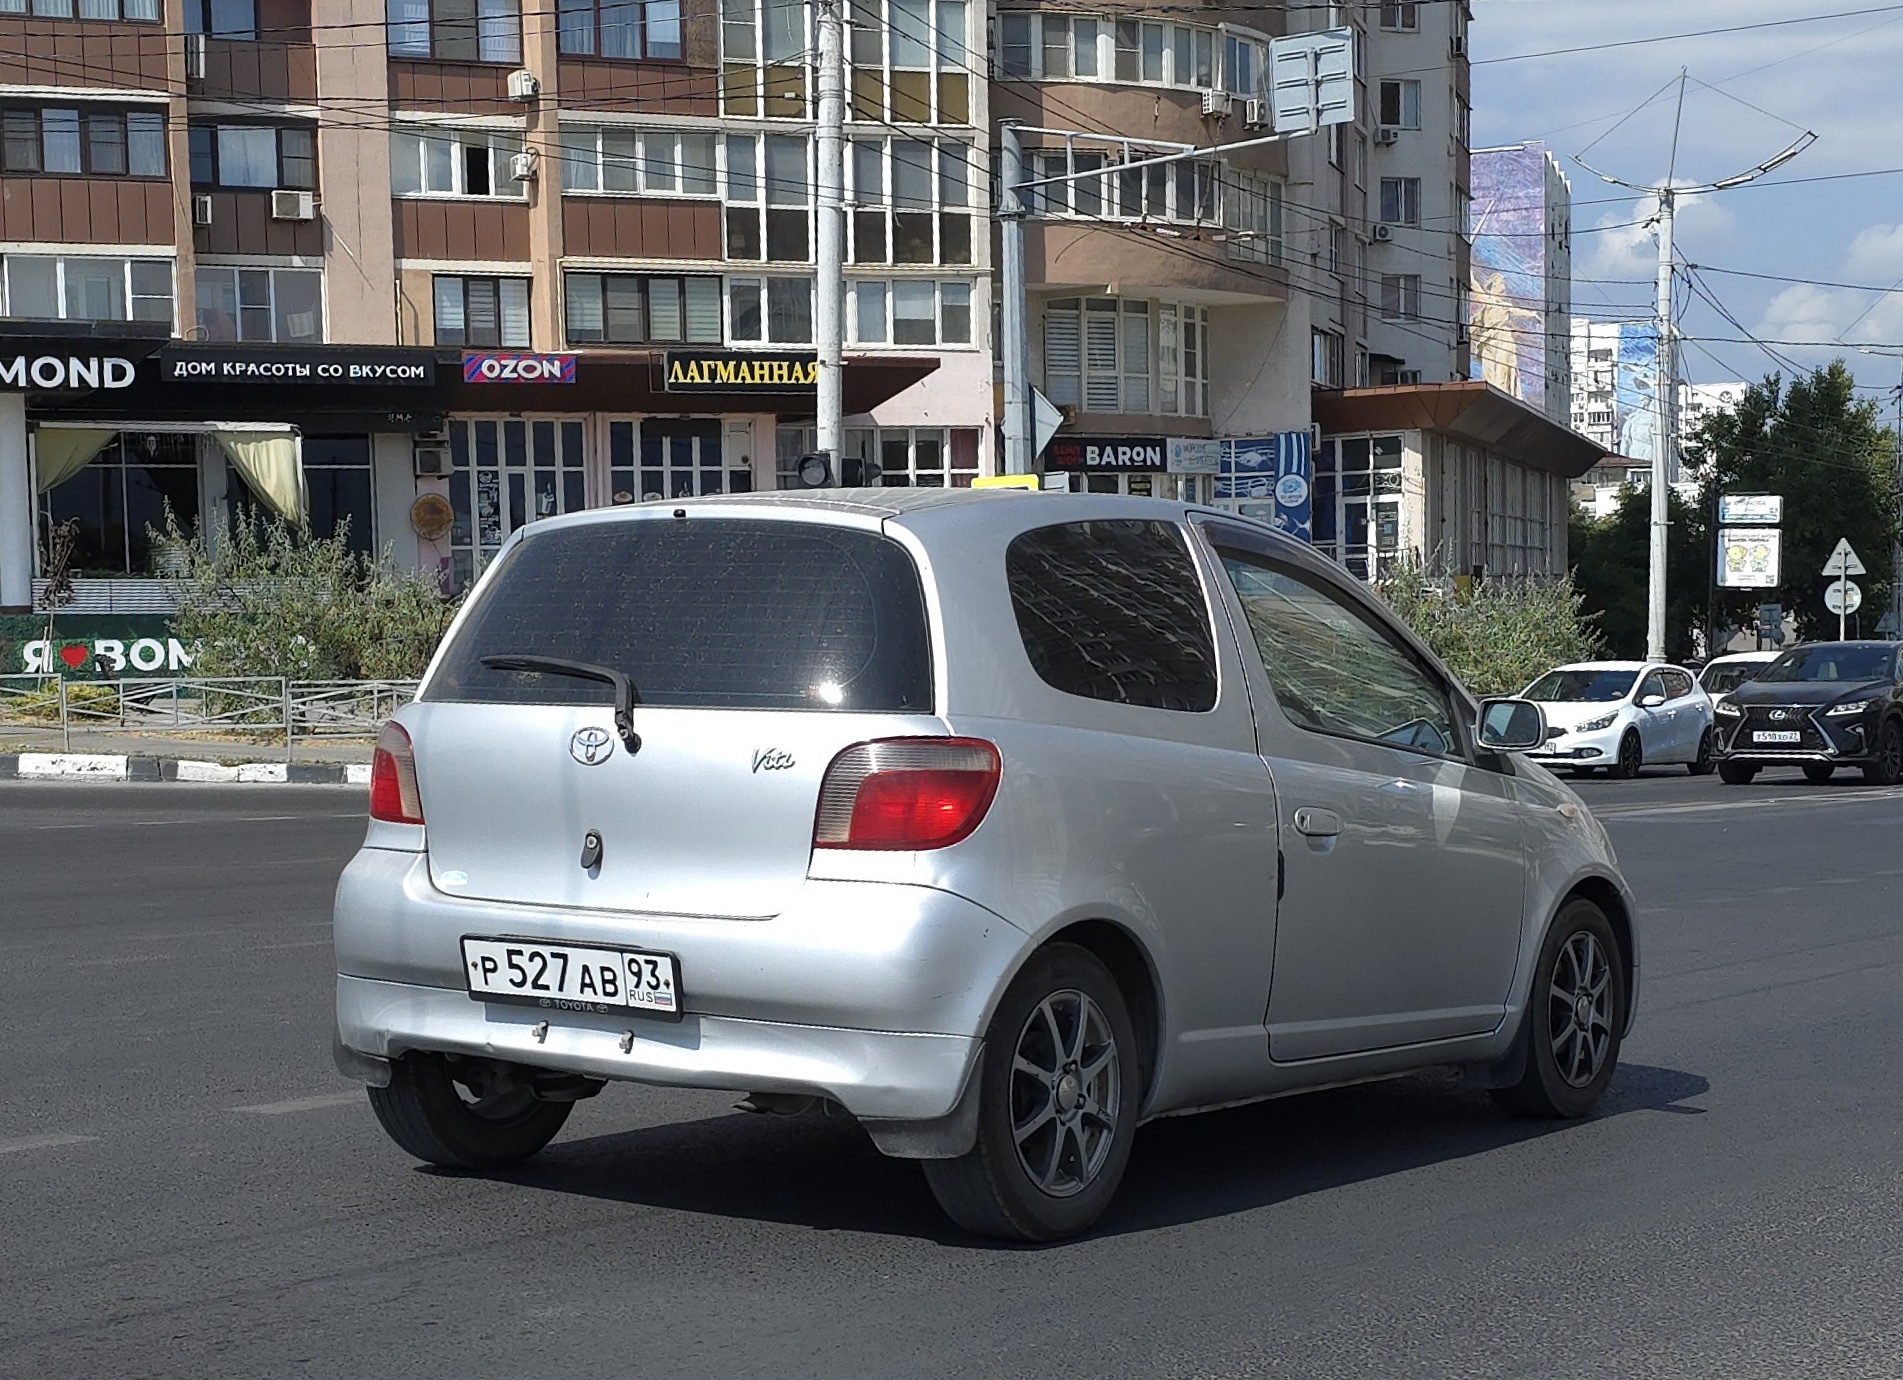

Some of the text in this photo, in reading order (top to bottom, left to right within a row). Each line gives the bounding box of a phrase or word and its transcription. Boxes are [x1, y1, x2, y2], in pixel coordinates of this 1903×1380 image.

[0, 356, 135, 388] MOND
[173, 361, 425, 379] ДОМ КРАСОТЫ СО ВКУСОМ
[481, 359, 561, 378] OZON
[668, 359, 818, 385] ЛАГМАННАЯ
[1086, 445, 1161, 466] BARON
[626, 957, 661, 990] 93
[552, 999, 594, 1012] TOYOTA
[629, 988, 653, 1003] RUS
